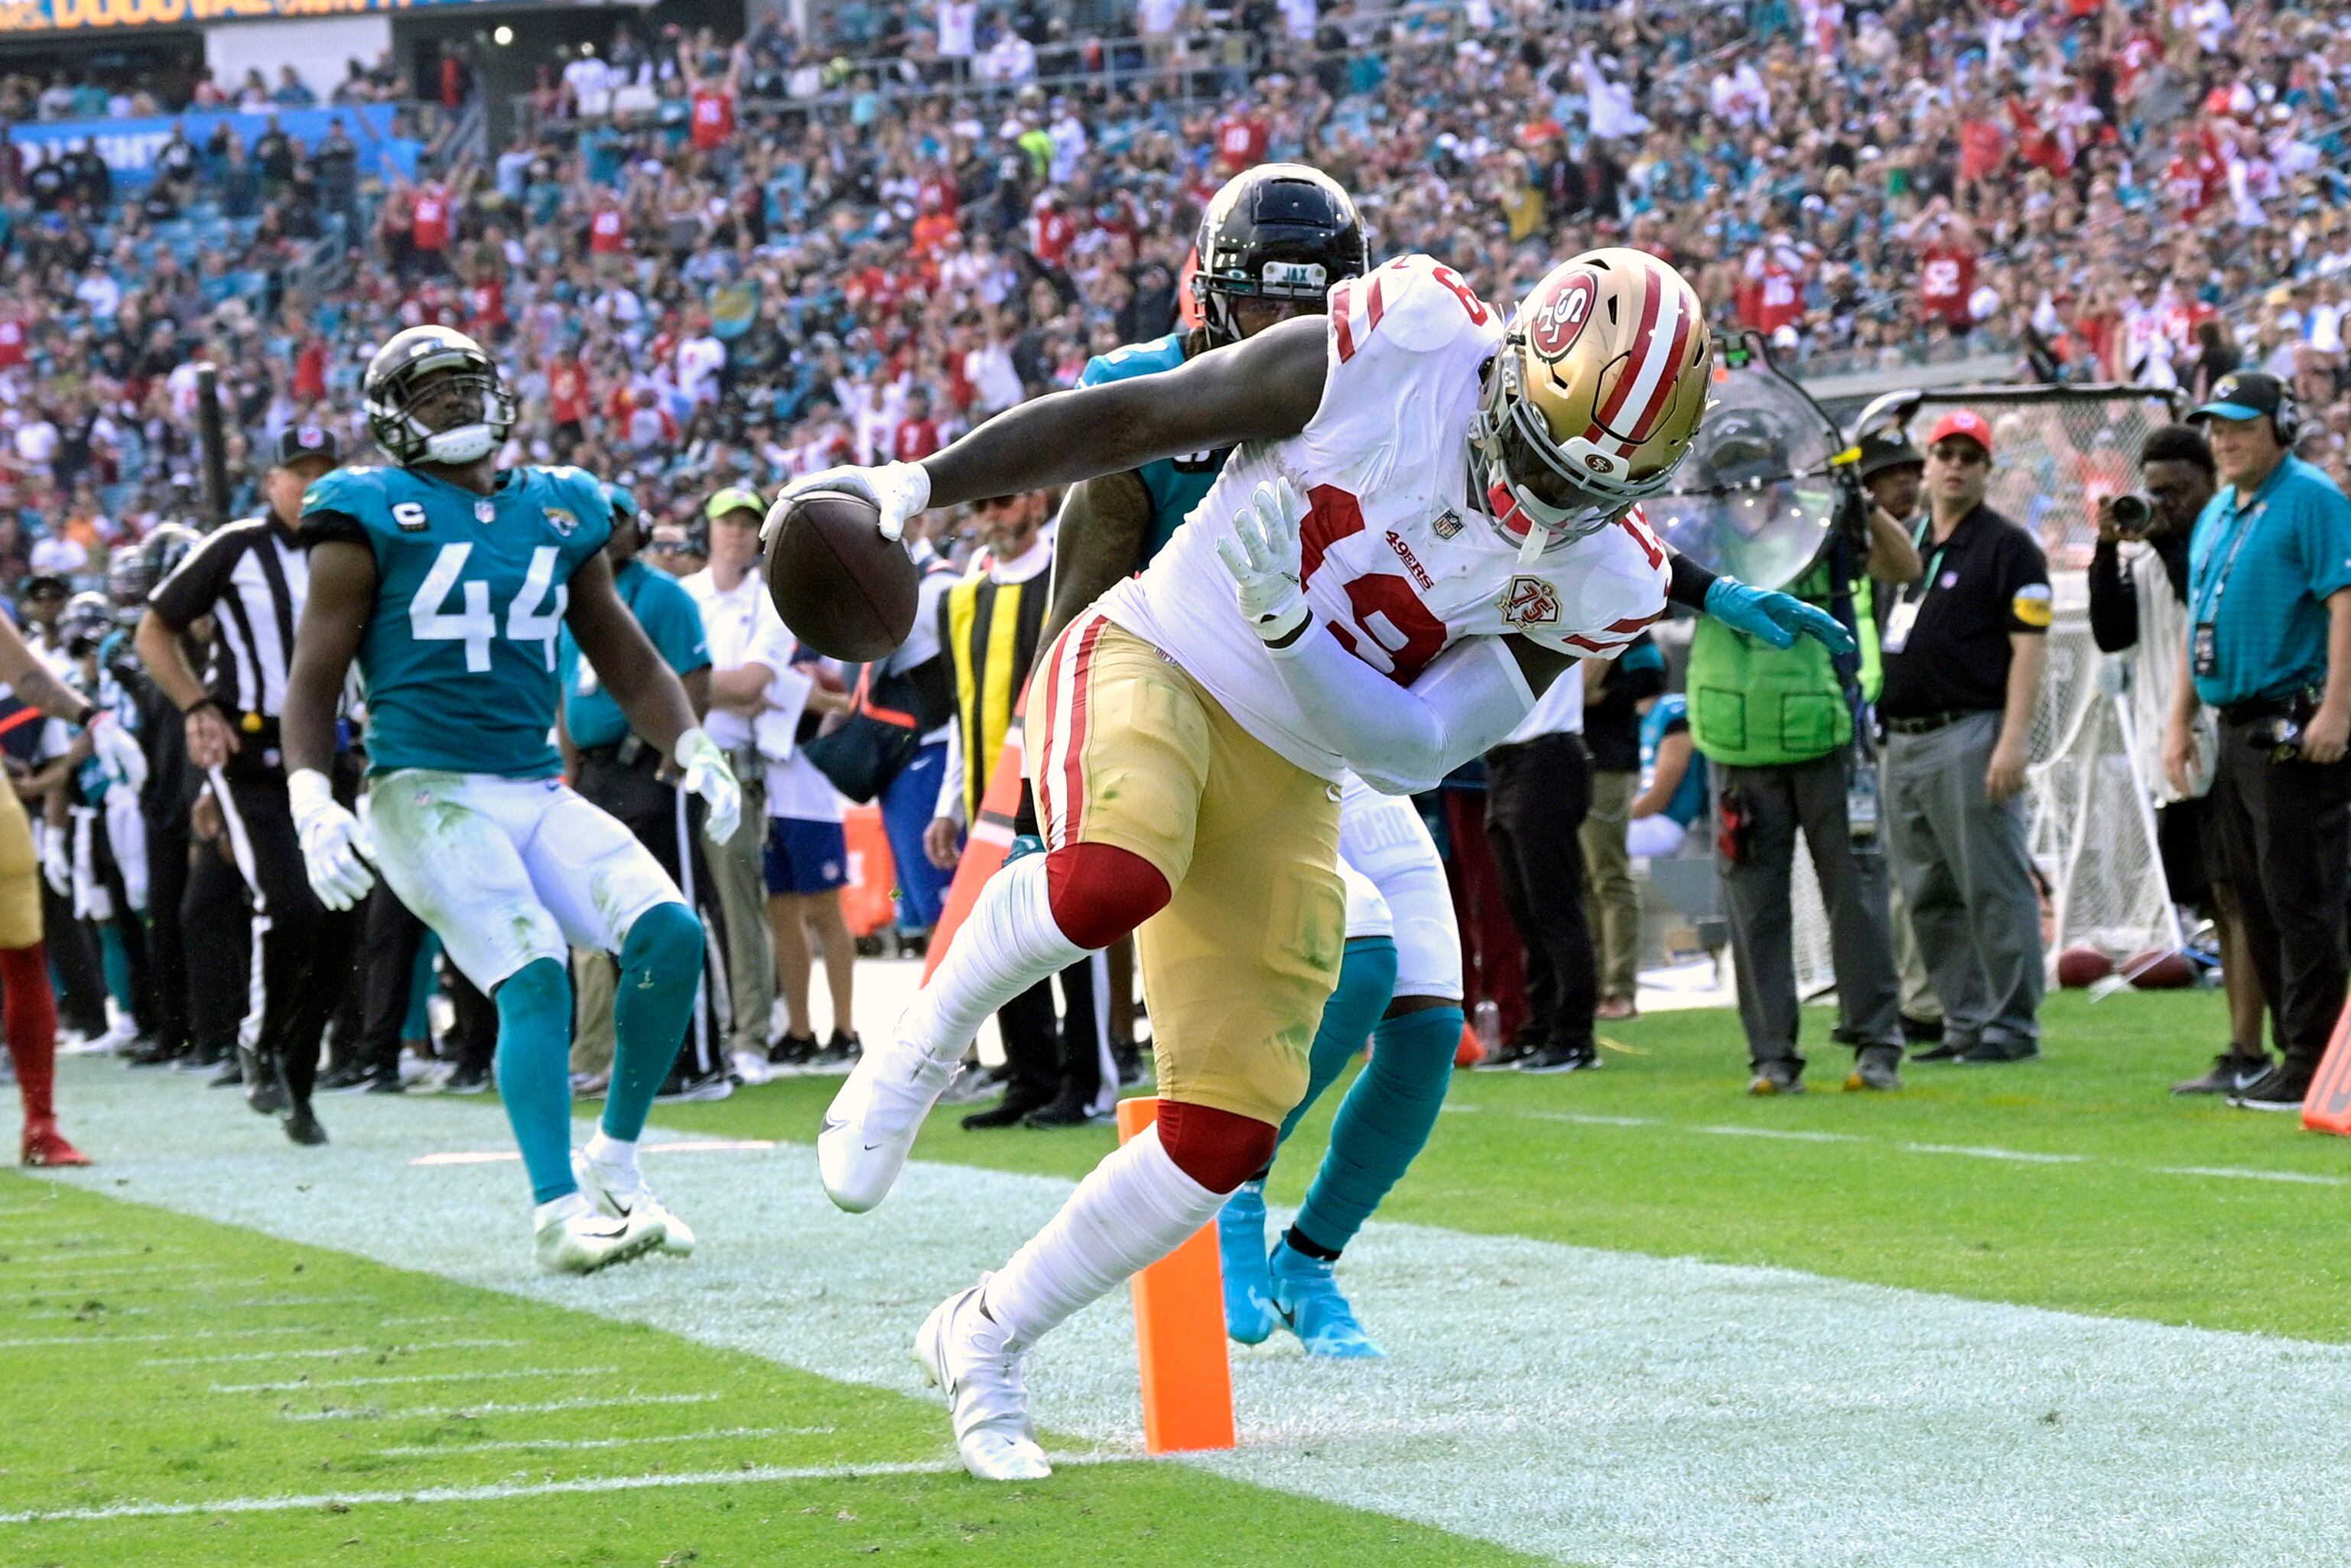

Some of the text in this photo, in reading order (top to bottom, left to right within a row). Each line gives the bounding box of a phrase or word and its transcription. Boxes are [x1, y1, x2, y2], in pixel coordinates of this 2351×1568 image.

[1282, 266, 1308, 282] JAX
[392, 501, 428, 526] C
[1385, 529, 1435, 592] 49ERS
[408, 542, 569, 673] 44
[1510, 581, 1554, 624] 75
